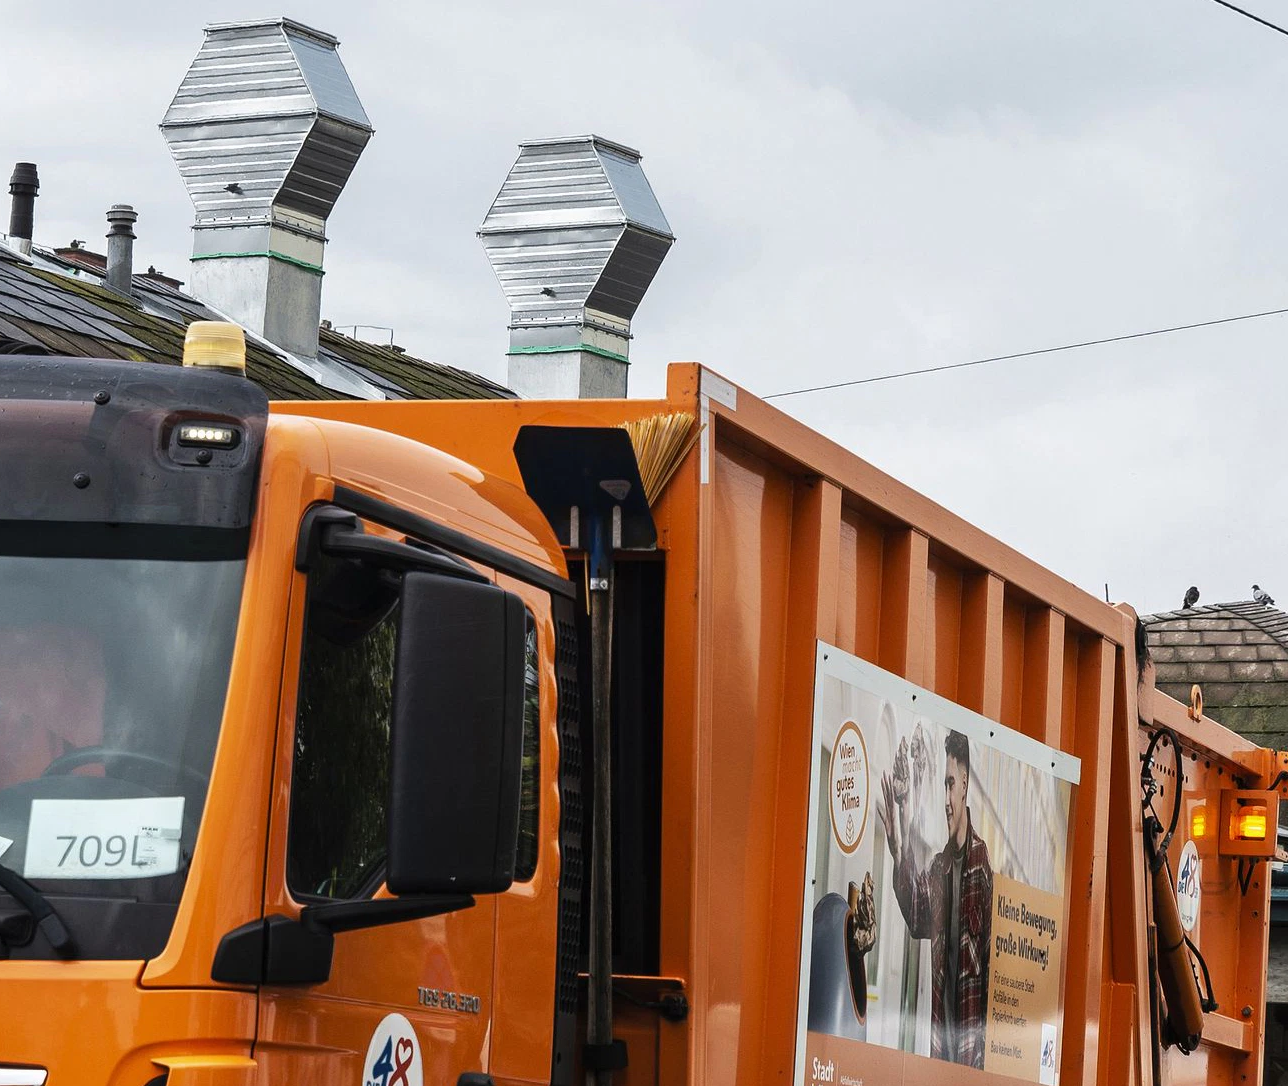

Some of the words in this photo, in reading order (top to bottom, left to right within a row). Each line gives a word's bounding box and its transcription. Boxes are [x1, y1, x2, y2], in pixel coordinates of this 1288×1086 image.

[840, 743, 855, 759] Wien
[837, 776, 854, 797] gutes
[842, 793, 859, 811] Klima
[997, 894, 1019, 922] Kleine
[1021, 903, 1057, 940] Bewegung,
[995, 932, 1017, 958] große
[1019, 936, 1049, 971] Wirkung!
[813, 1056, 834, 1082] Stadt
